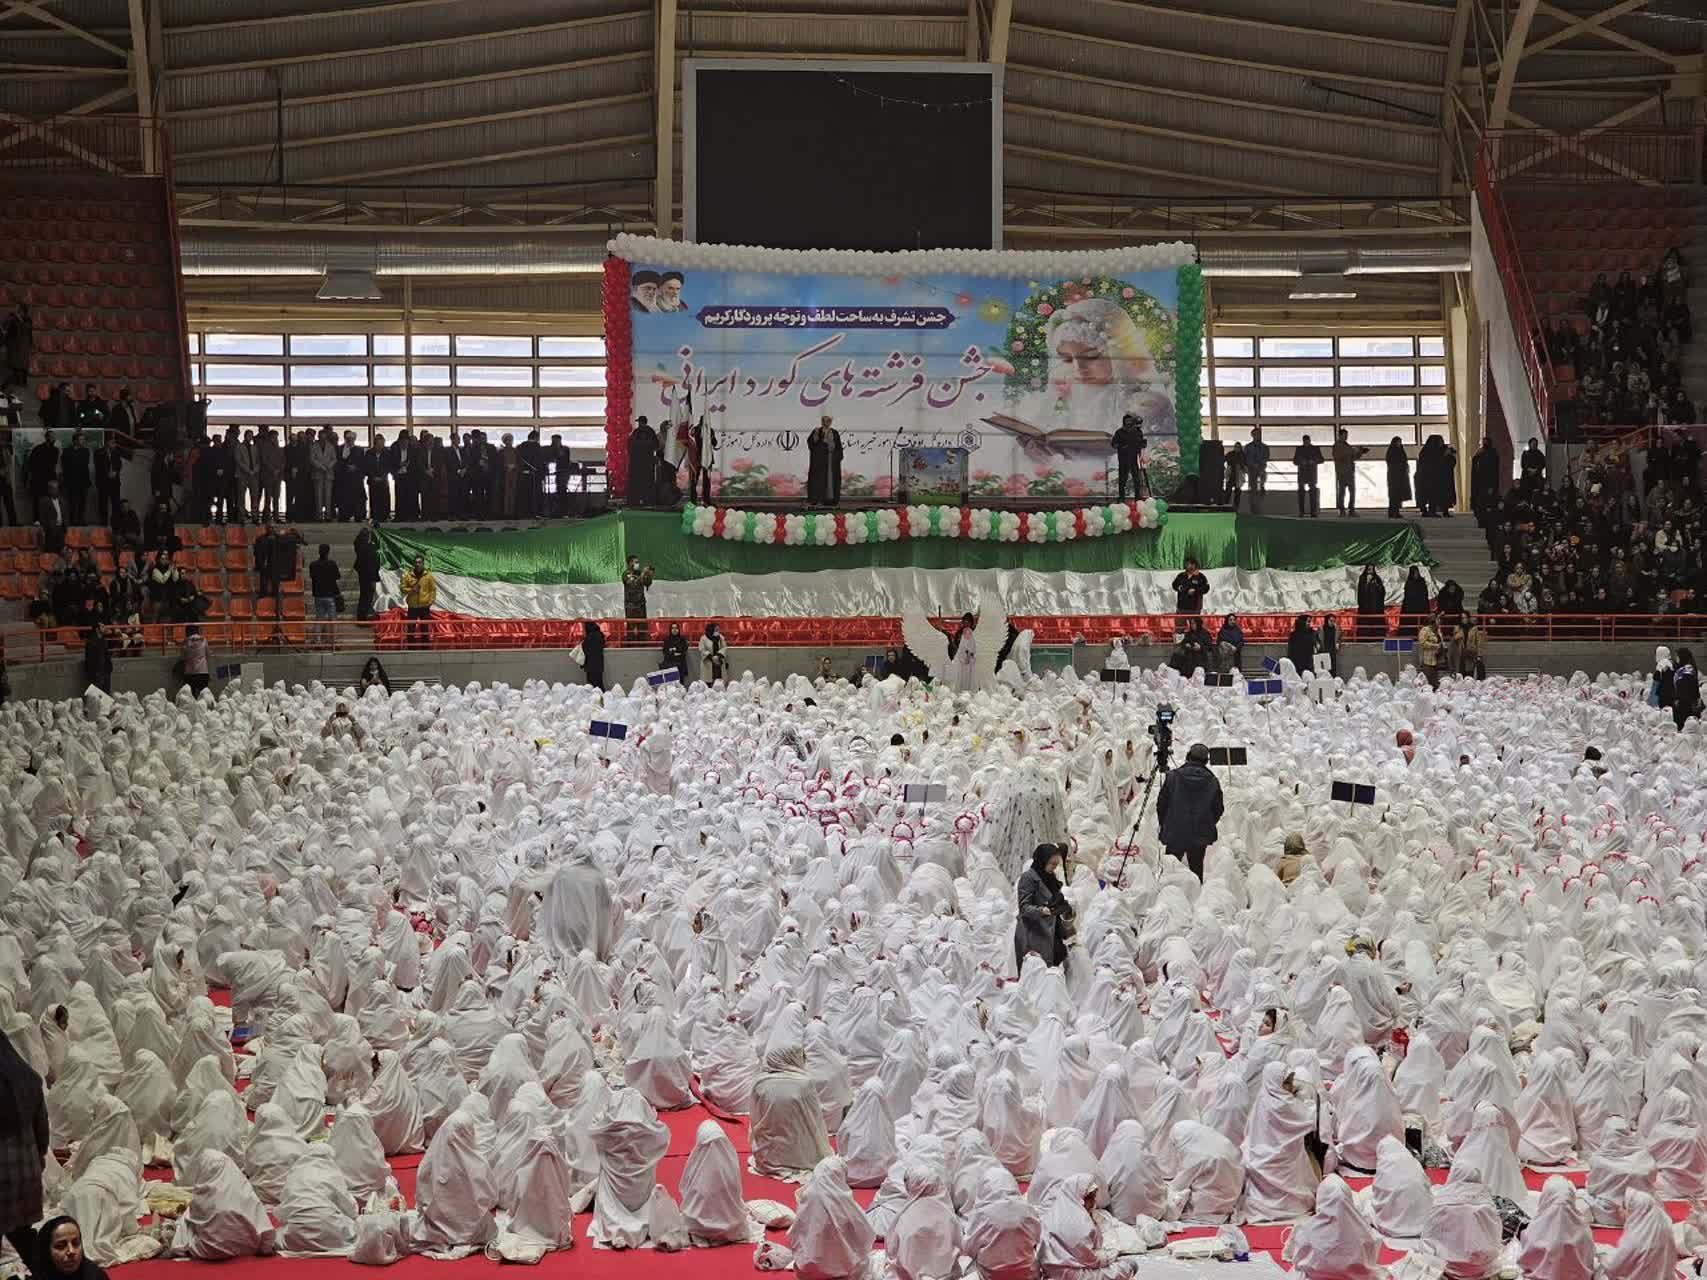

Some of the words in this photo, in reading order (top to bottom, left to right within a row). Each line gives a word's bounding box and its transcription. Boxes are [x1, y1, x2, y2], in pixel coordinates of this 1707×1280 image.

[704, 309, 732, 325] کریم
[728, 308, 773, 327] پروردگار
[800, 314, 807, 326] و
[807, 308, 836, 323] لطف
[836, 309, 872, 323] ساحت
[872, 311, 884, 325] به
[885, 308, 916, 326] تشرف
[916, 311, 946, 326] جشن
[660, 345, 739, 413] ایرانی
[800, 358, 855, 408] های
[857, 351, 925, 408] فرشته
[926, 345, 993, 409] جشن
